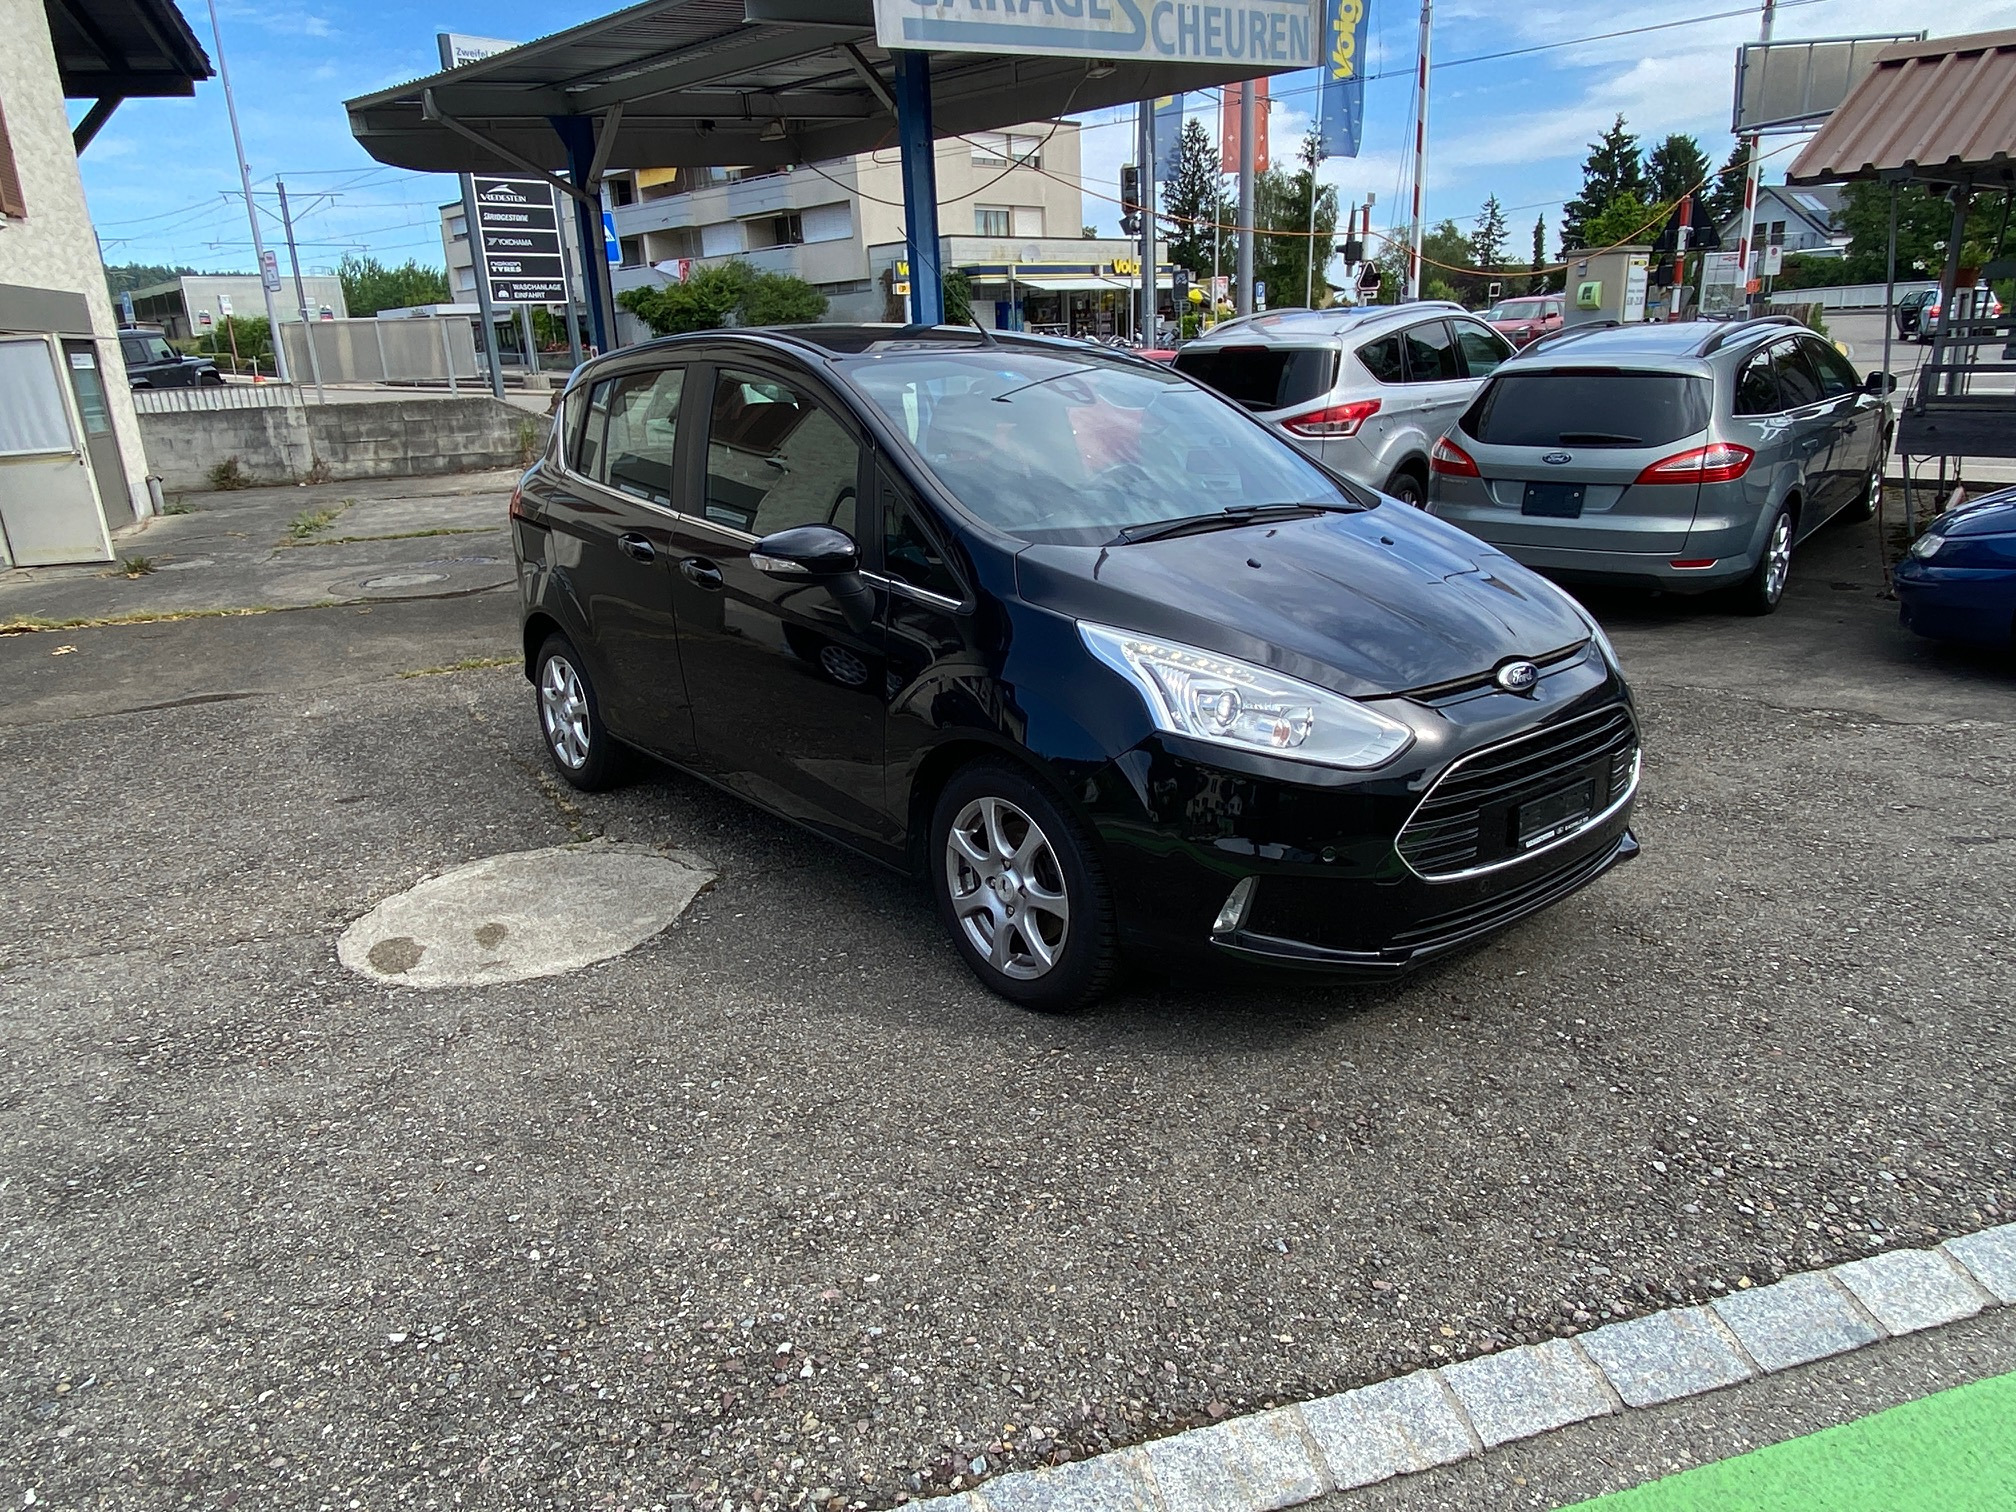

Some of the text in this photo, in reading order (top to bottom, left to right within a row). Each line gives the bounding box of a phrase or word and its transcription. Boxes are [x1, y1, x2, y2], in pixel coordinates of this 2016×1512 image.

[1332, 0, 1363, 80] Volg
[456, 47, 488, 58] Zweifel
[480, 193, 527, 203] VREDESTEIN
[483, 212, 529, 222] BRIDGESTONE
[498, 238, 533, 247] YOKOHAMA
[1112, 258, 1140, 276] Volg
[512, 283, 562, 291] WASCHANLAGE
[514, 291, 545, 299] EINFAHRT
[1512, 667, 1532, 684] Ford
